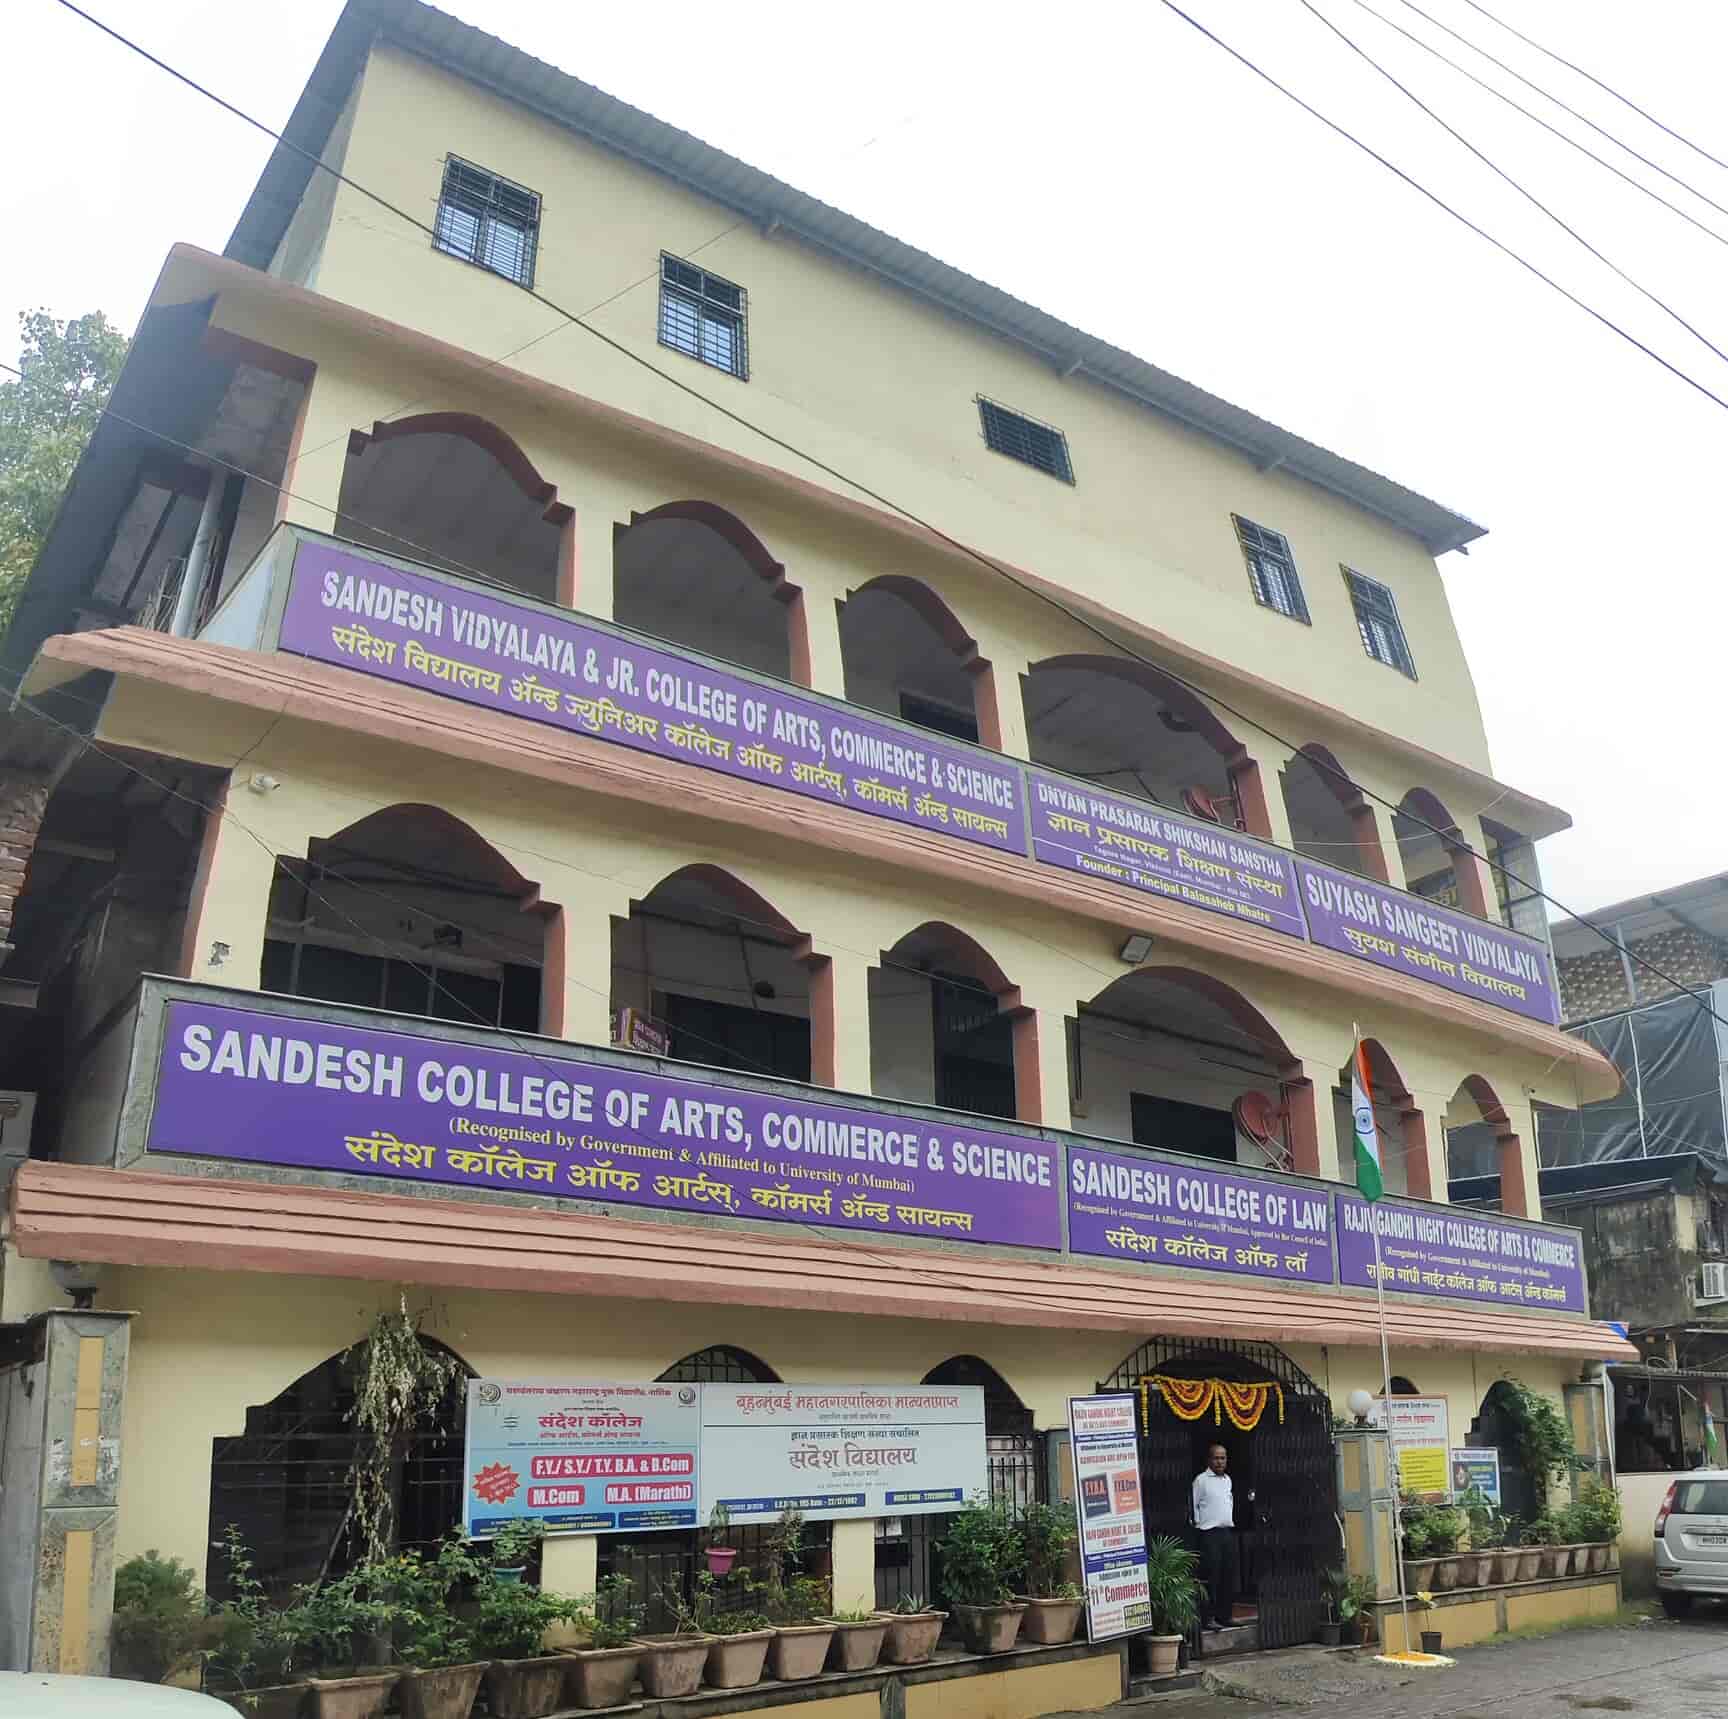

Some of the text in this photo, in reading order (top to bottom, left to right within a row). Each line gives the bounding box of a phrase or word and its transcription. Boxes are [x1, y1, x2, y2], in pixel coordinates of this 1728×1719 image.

[321, 571, 1014, 809] SANDESH VIDYALAYA & JR. COLLEGE OF ARTS, COMMERCE & SCIENCE
[332, 624, 396, 665] संदेश
[404, 640, 503, 696] विद्यालय
[663, 721, 731, 761] कॉलेज
[735, 740, 785, 775] ऑफ
[853, 774, 909, 813] कॉमर्स
[952, 809, 1010, 840] सायन्स
[1038, 783, 1284, 879] DNYAN PRASARAK SHIKSHAN SANSTHA
[1075, 855, 1122, 877] Founder
[1132, 871, 1180, 896] Principal
[1305, 872, 1381, 928] SUYASH
[1382, 899, 1459, 955] SANGEET
[1462, 931, 1542, 985] VIDYALAYA
[180, 1024, 1051, 1187] SANDESH COLLEGE OF ARTS, COMMERCE & SCIENCE
[344, 1131, 436, 1168] संदेश
[446, 1144, 557, 1183] कॉलेज
[567, 1159, 641, 1192] ऑफ
[751, 1183, 832, 1216] कॉमर्स
[896, 1204, 974, 1232] सायन्स
[449, 1116, 915, 1193] (Recognised by Government & Affiliated to University of Mumbai)
[1072, 1158, 1327, 1233] SANDESH COLLEGE OF LAW
[1105, 1225, 1157, 1253] संदेश
[1164, 1234, 1229, 1263] कॉलेज
[1234, 1245, 1279, 1270] ऑफ
[1376, 1210, 1414, 1240] GANDHI
[1415, 1216, 1445, 1245] NIGHT
[1447, 1221, 1487, 1252] COLLEGE
[1488, 1229, 1499, 1255] OF
[1501, 1231, 1522, 1257] ARTS
[1532, 1238, 1575, 1268] COMMERCE
[537, 1413, 643, 1430] संदेश कॉलेज
[788, 1442, 918, 1469] संदेश विद्यालय
[533, 1489, 579, 1505] M.Com
